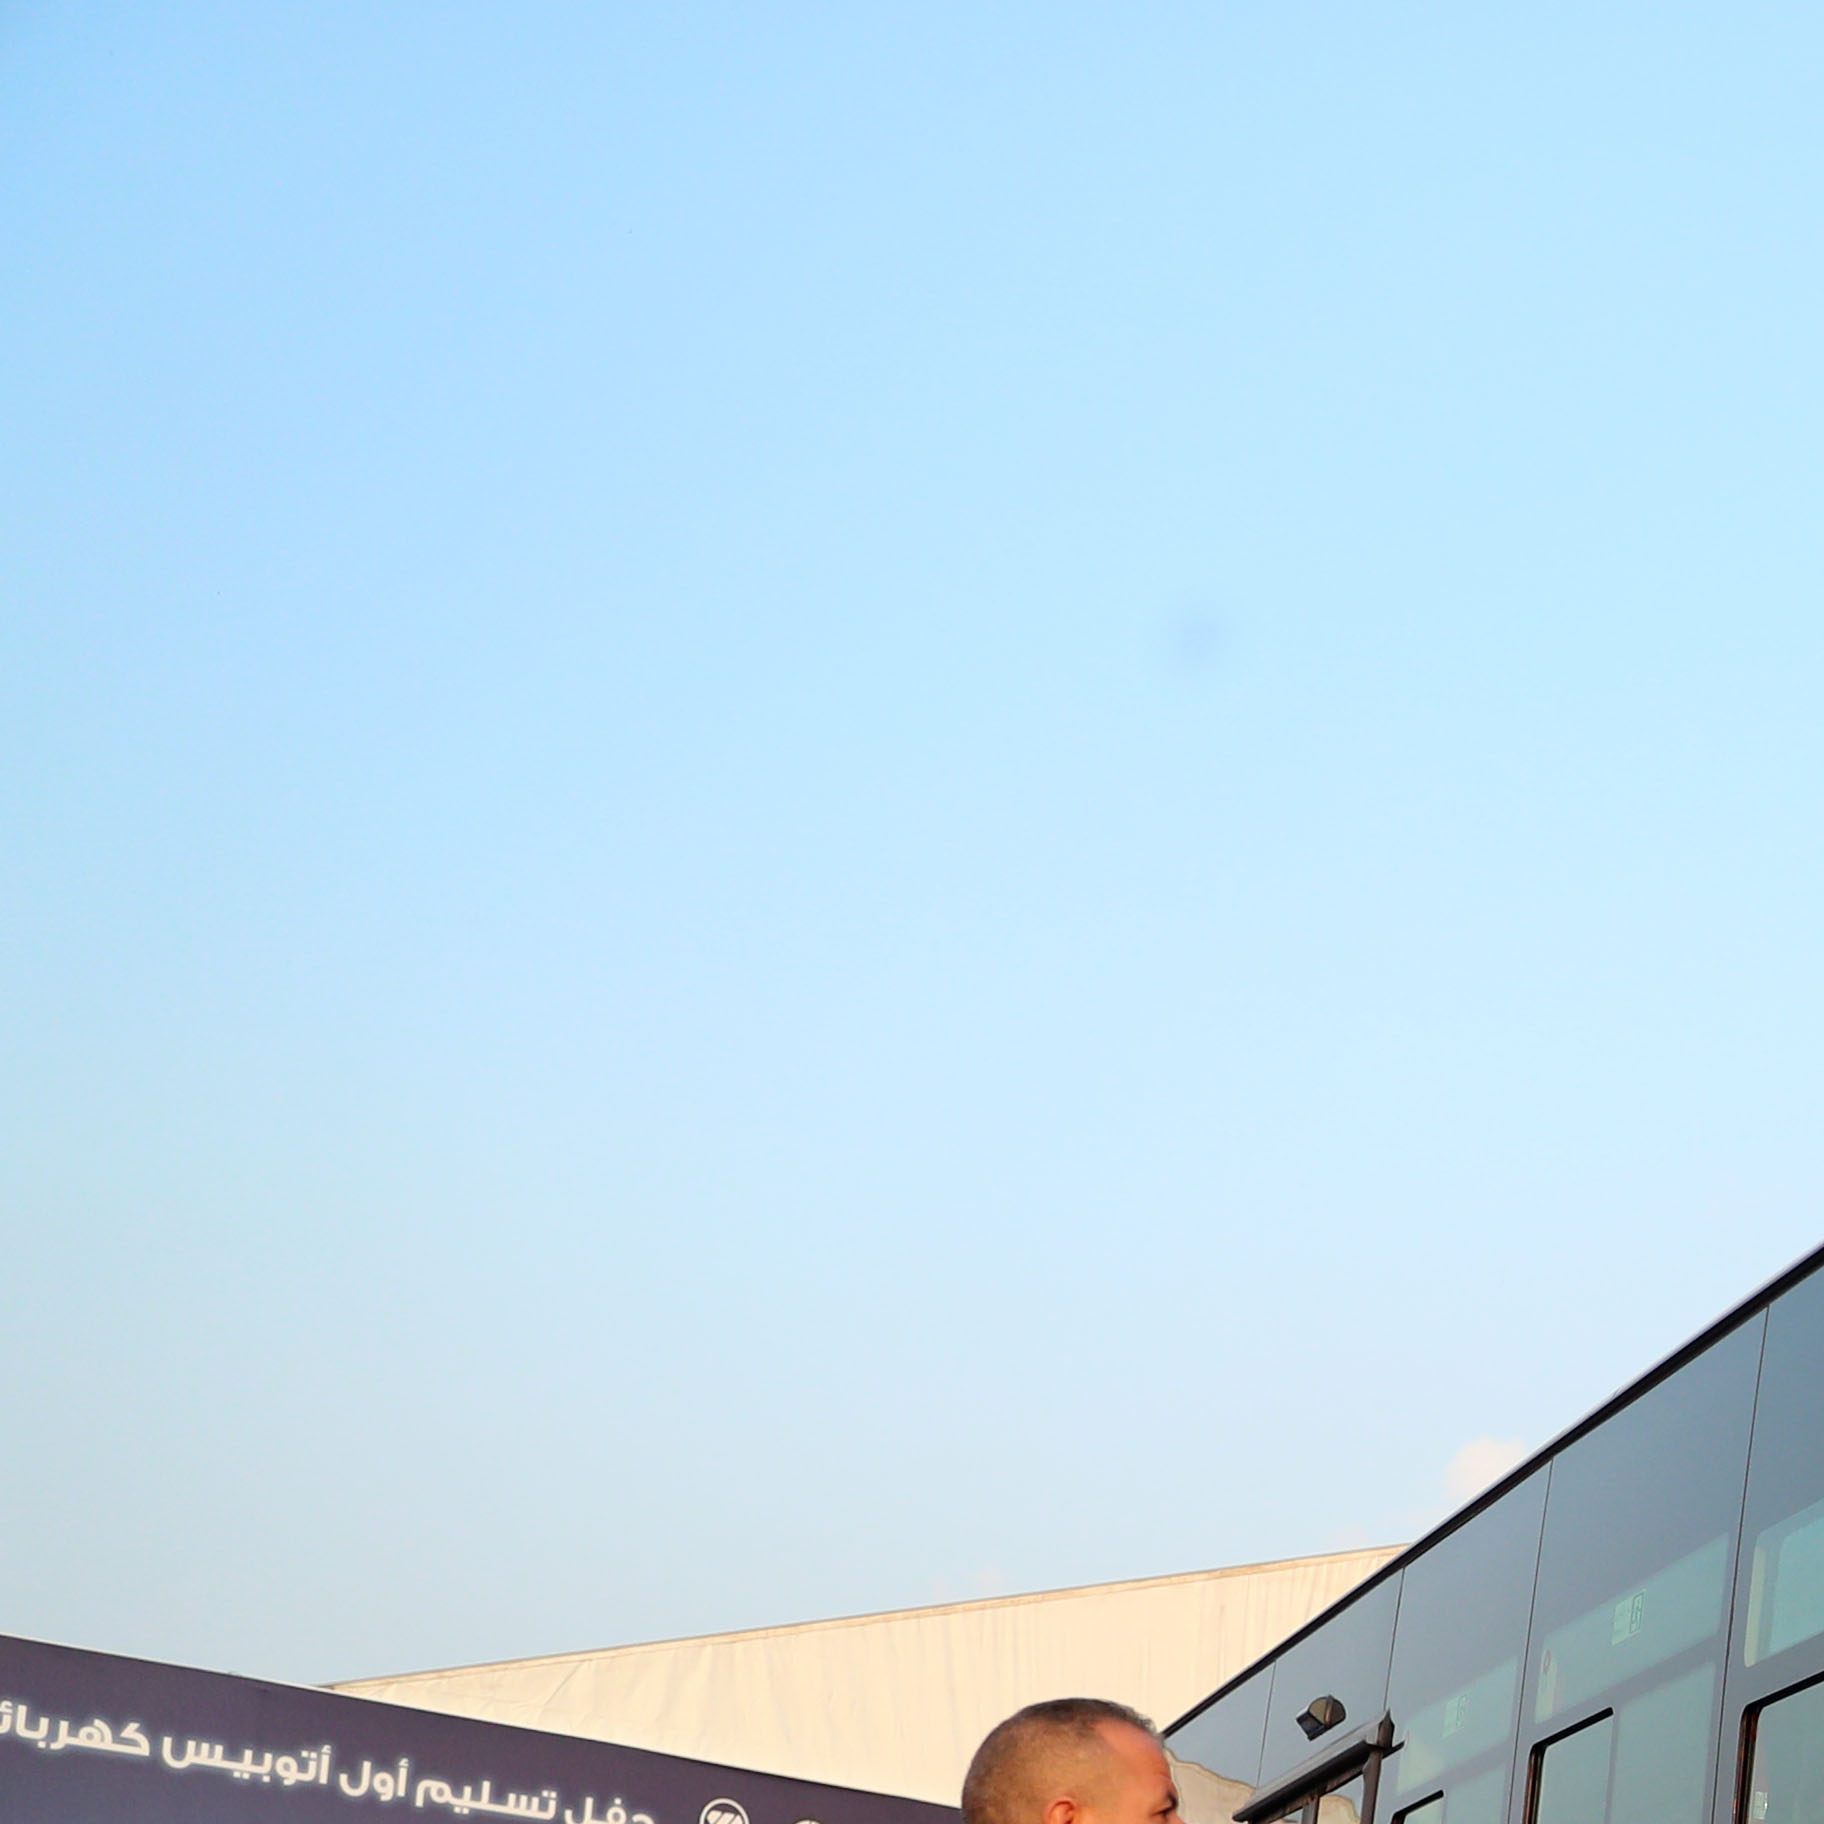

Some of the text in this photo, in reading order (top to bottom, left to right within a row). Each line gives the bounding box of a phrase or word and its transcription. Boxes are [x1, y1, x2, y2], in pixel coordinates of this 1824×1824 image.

[162, 1735, 331, 1785] أتوبيس
[339, 1757, 409, 1801] أول
[415, 1779, 557, 1820] تسليم
